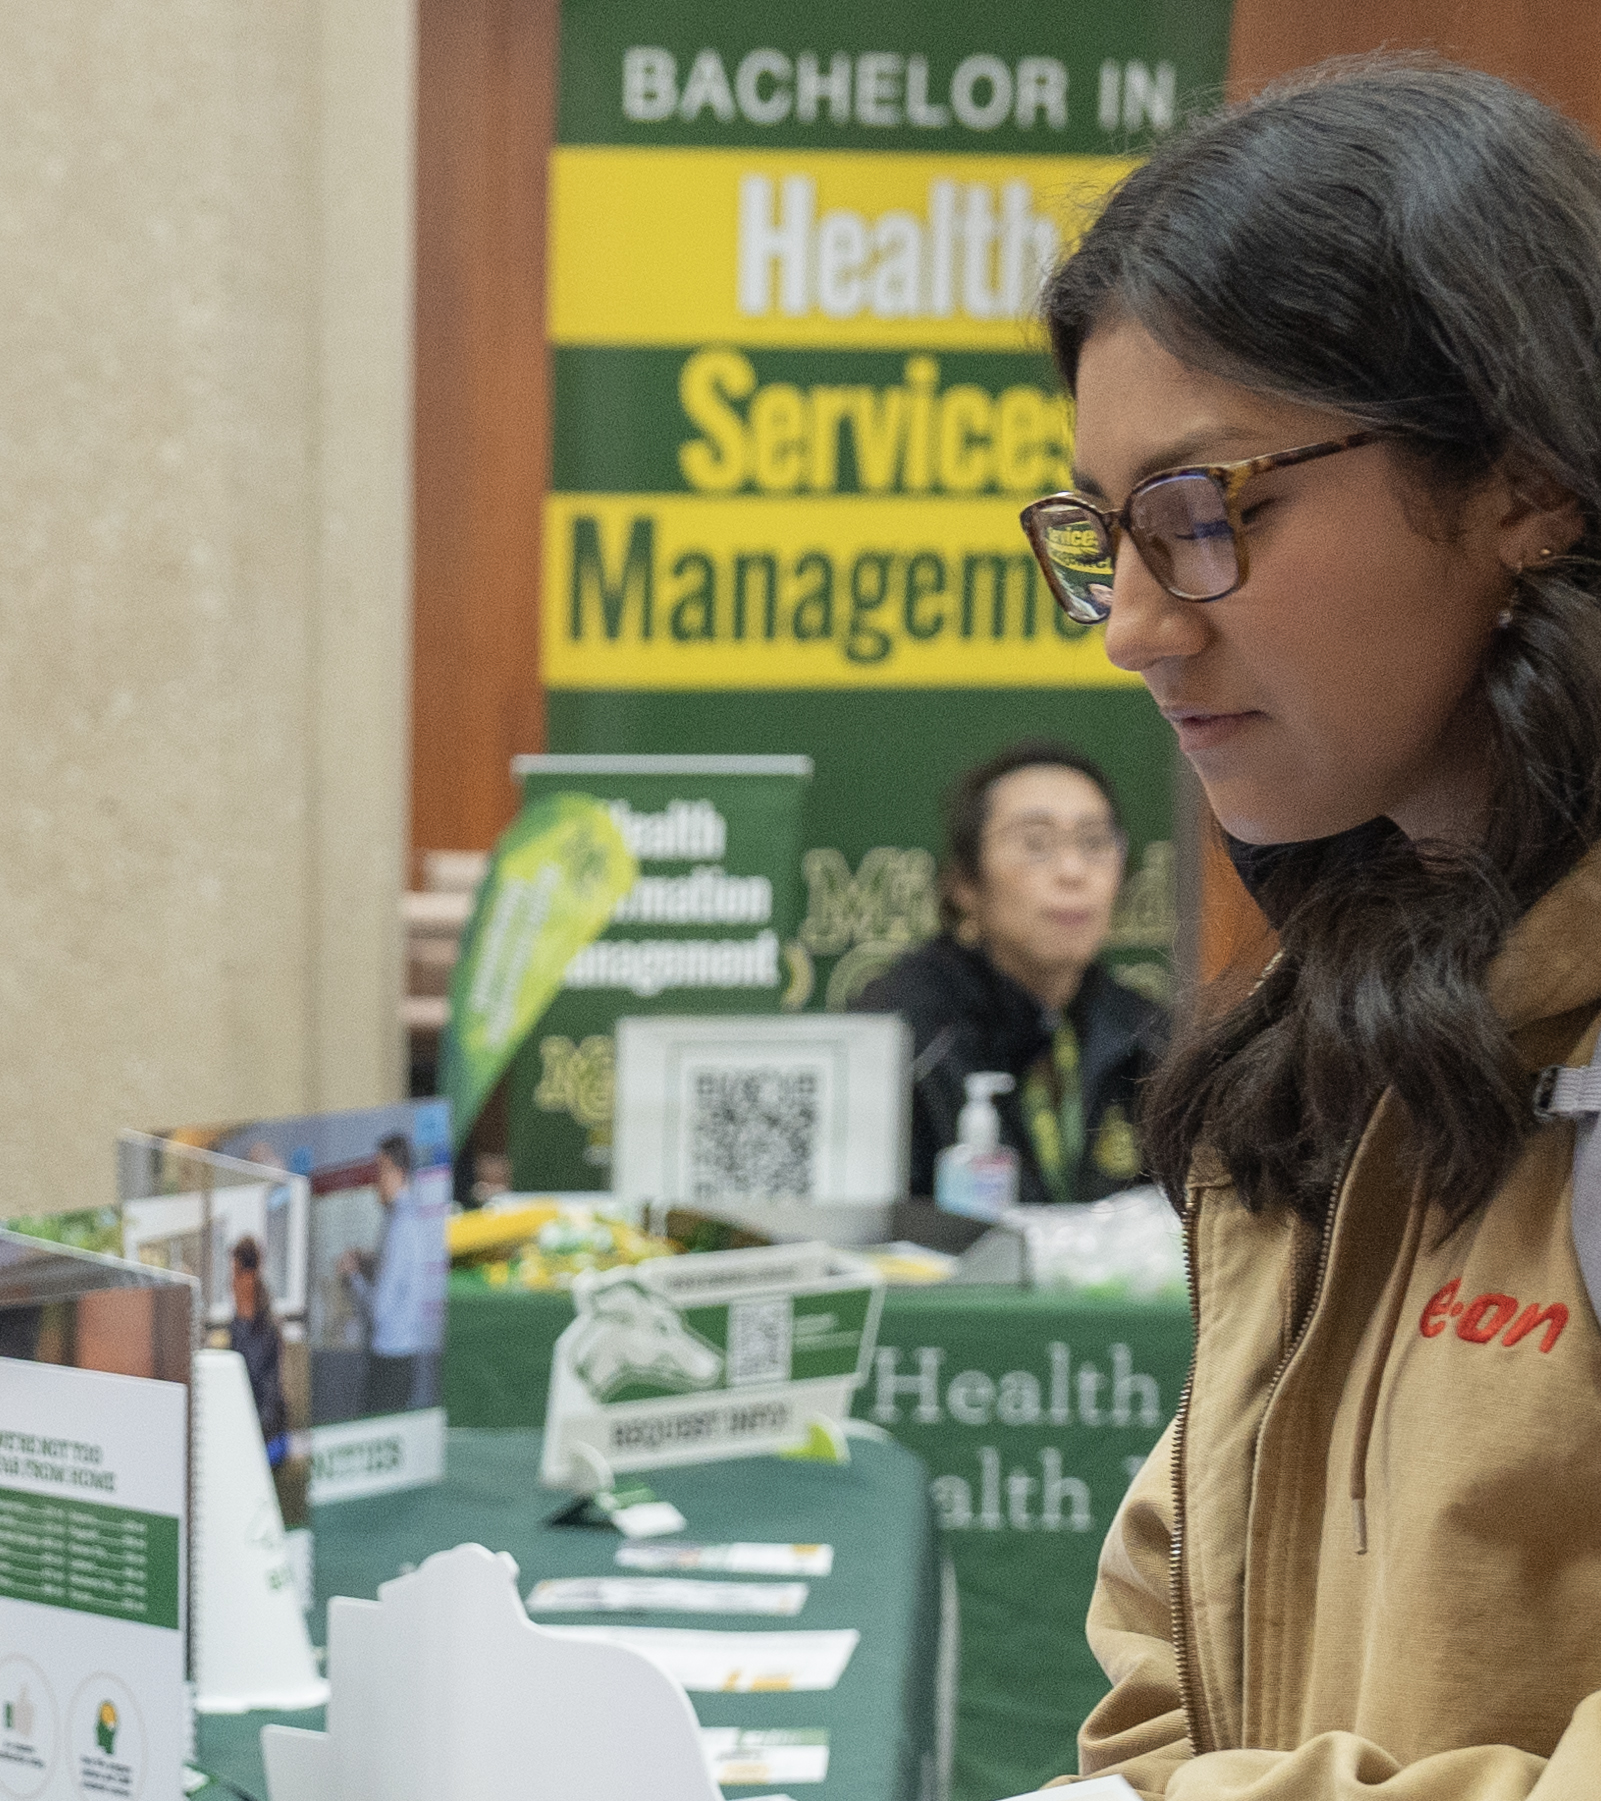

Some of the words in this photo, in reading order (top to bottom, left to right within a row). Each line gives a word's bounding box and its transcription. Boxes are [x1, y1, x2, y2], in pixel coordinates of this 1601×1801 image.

[622, 45, 1069, 131] BACHELOR
[1099, 58, 1176, 131] IN
[737, 174, 1062, 322] Health
[873, 1340, 1161, 1428] Health
